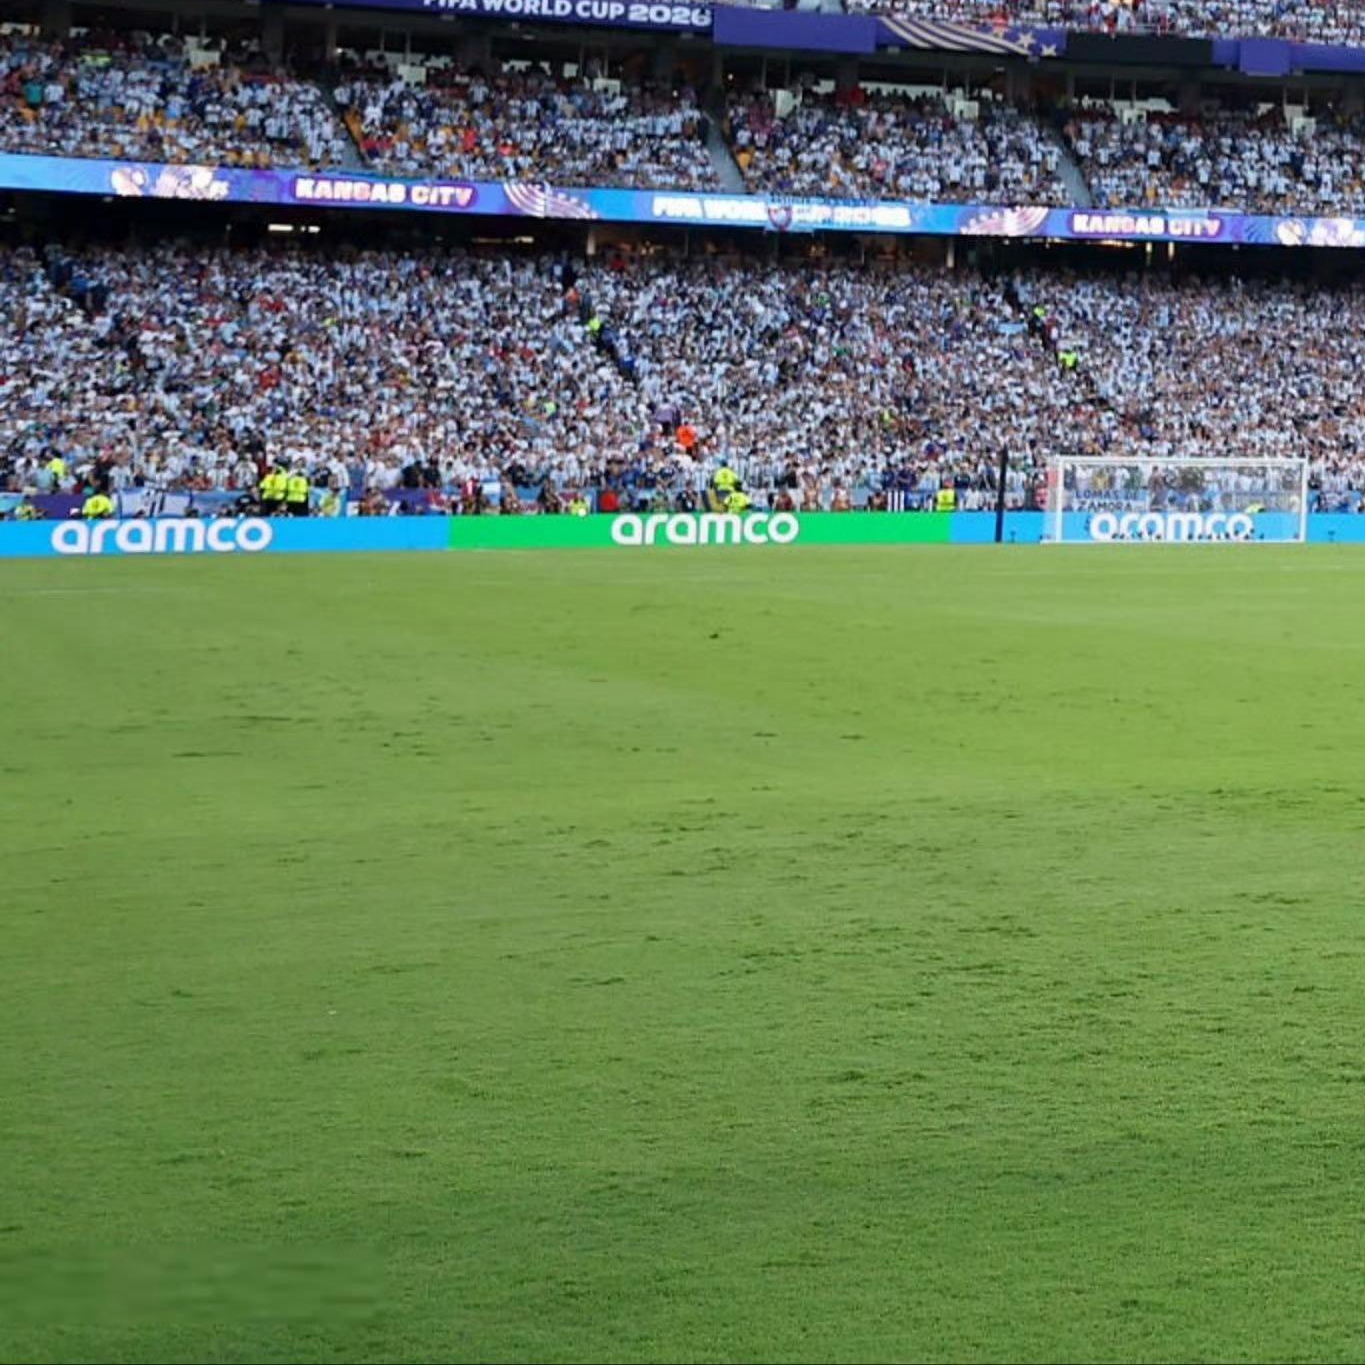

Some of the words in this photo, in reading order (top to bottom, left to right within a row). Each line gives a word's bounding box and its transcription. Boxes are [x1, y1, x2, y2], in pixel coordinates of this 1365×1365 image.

[576, 0, 625, 21] CUP
[628, 3, 712, 27] 2026
[295, 178, 406, 203] KANSAS
[411, 185, 473, 207] CITY
[1073, 213, 1165, 233] KANSAS
[1168, 217, 1221, 237] CITY
[51, 518, 273, 554] aramco
[611, 512, 799, 545] aramco
[1090, 512, 1254, 541] aramco
